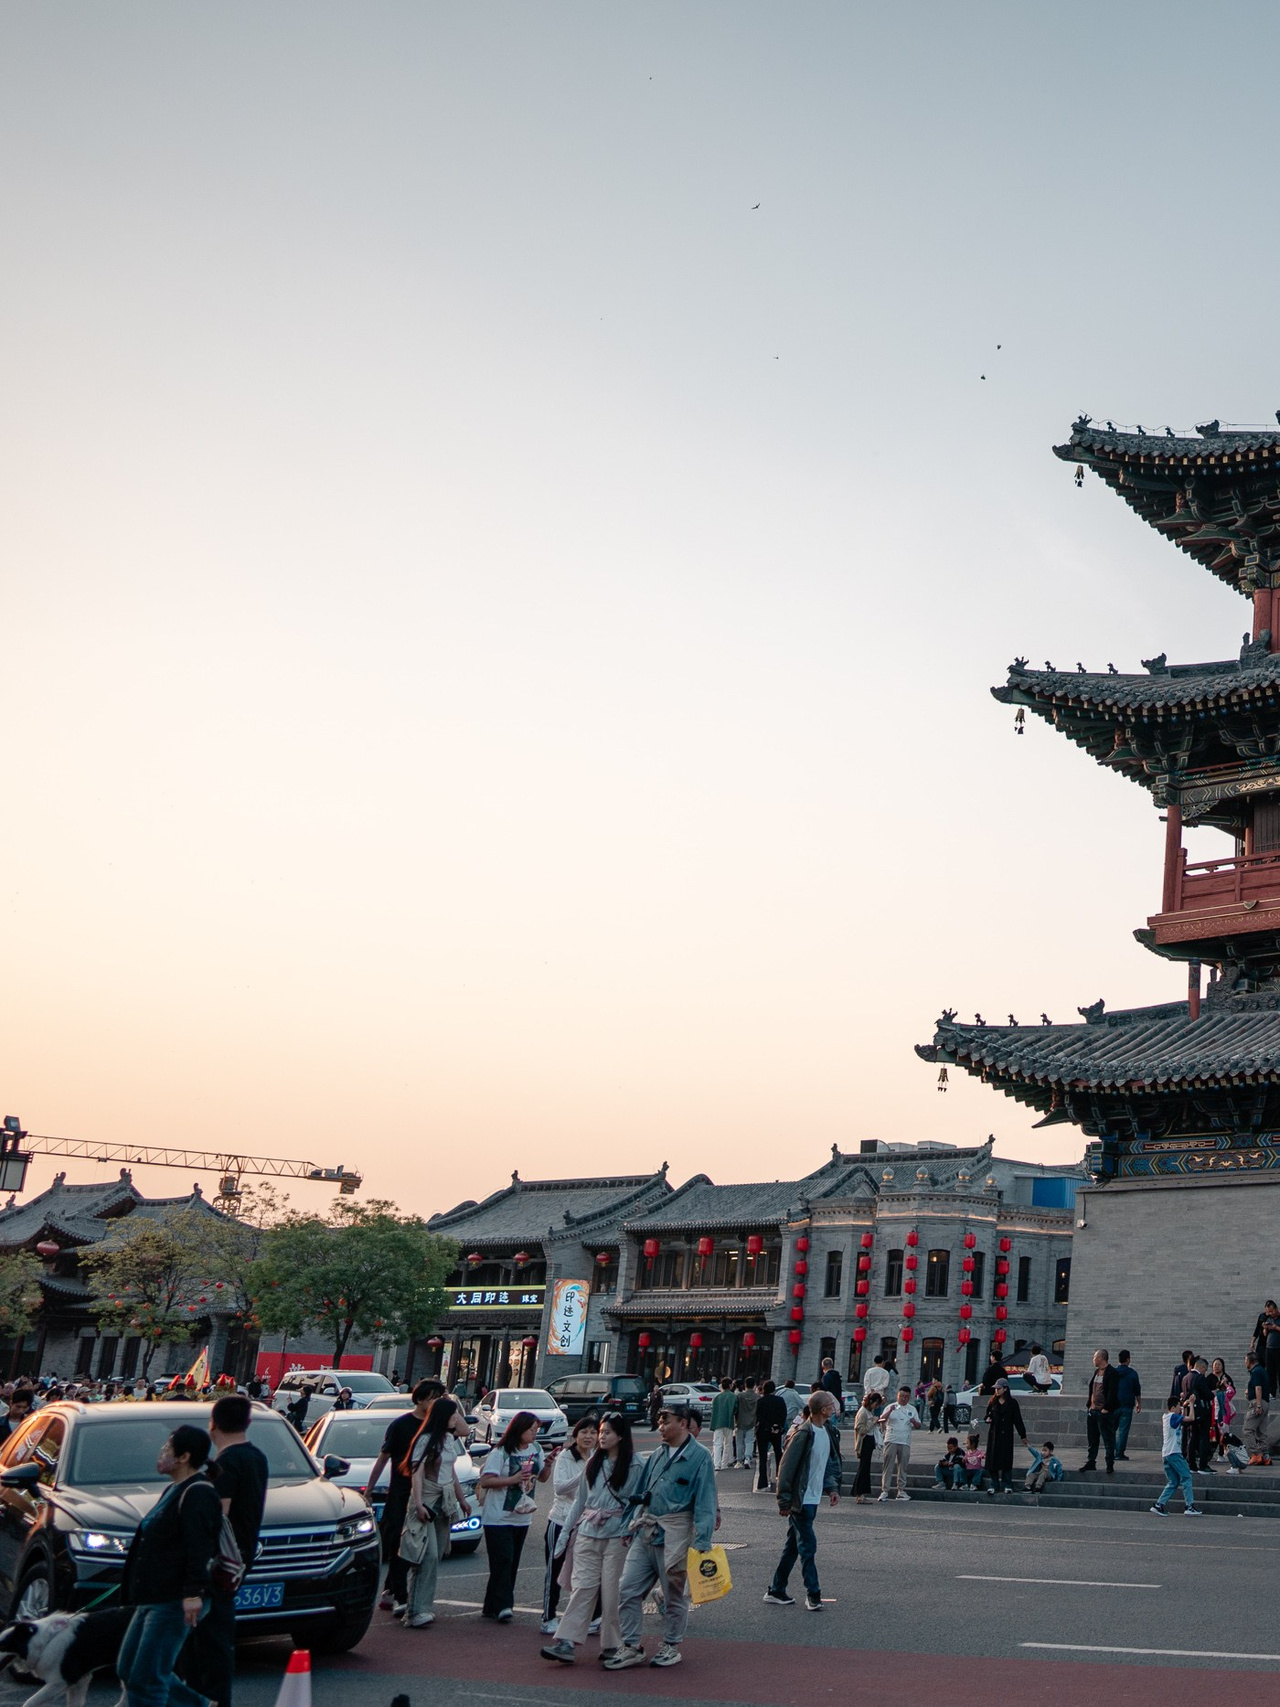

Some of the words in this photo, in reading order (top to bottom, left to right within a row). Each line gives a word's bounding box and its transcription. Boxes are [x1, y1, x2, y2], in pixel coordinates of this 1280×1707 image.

[456, 1291, 509, 1305] 大同印迹
[560, 1291, 575, 1348] 印迹文创
